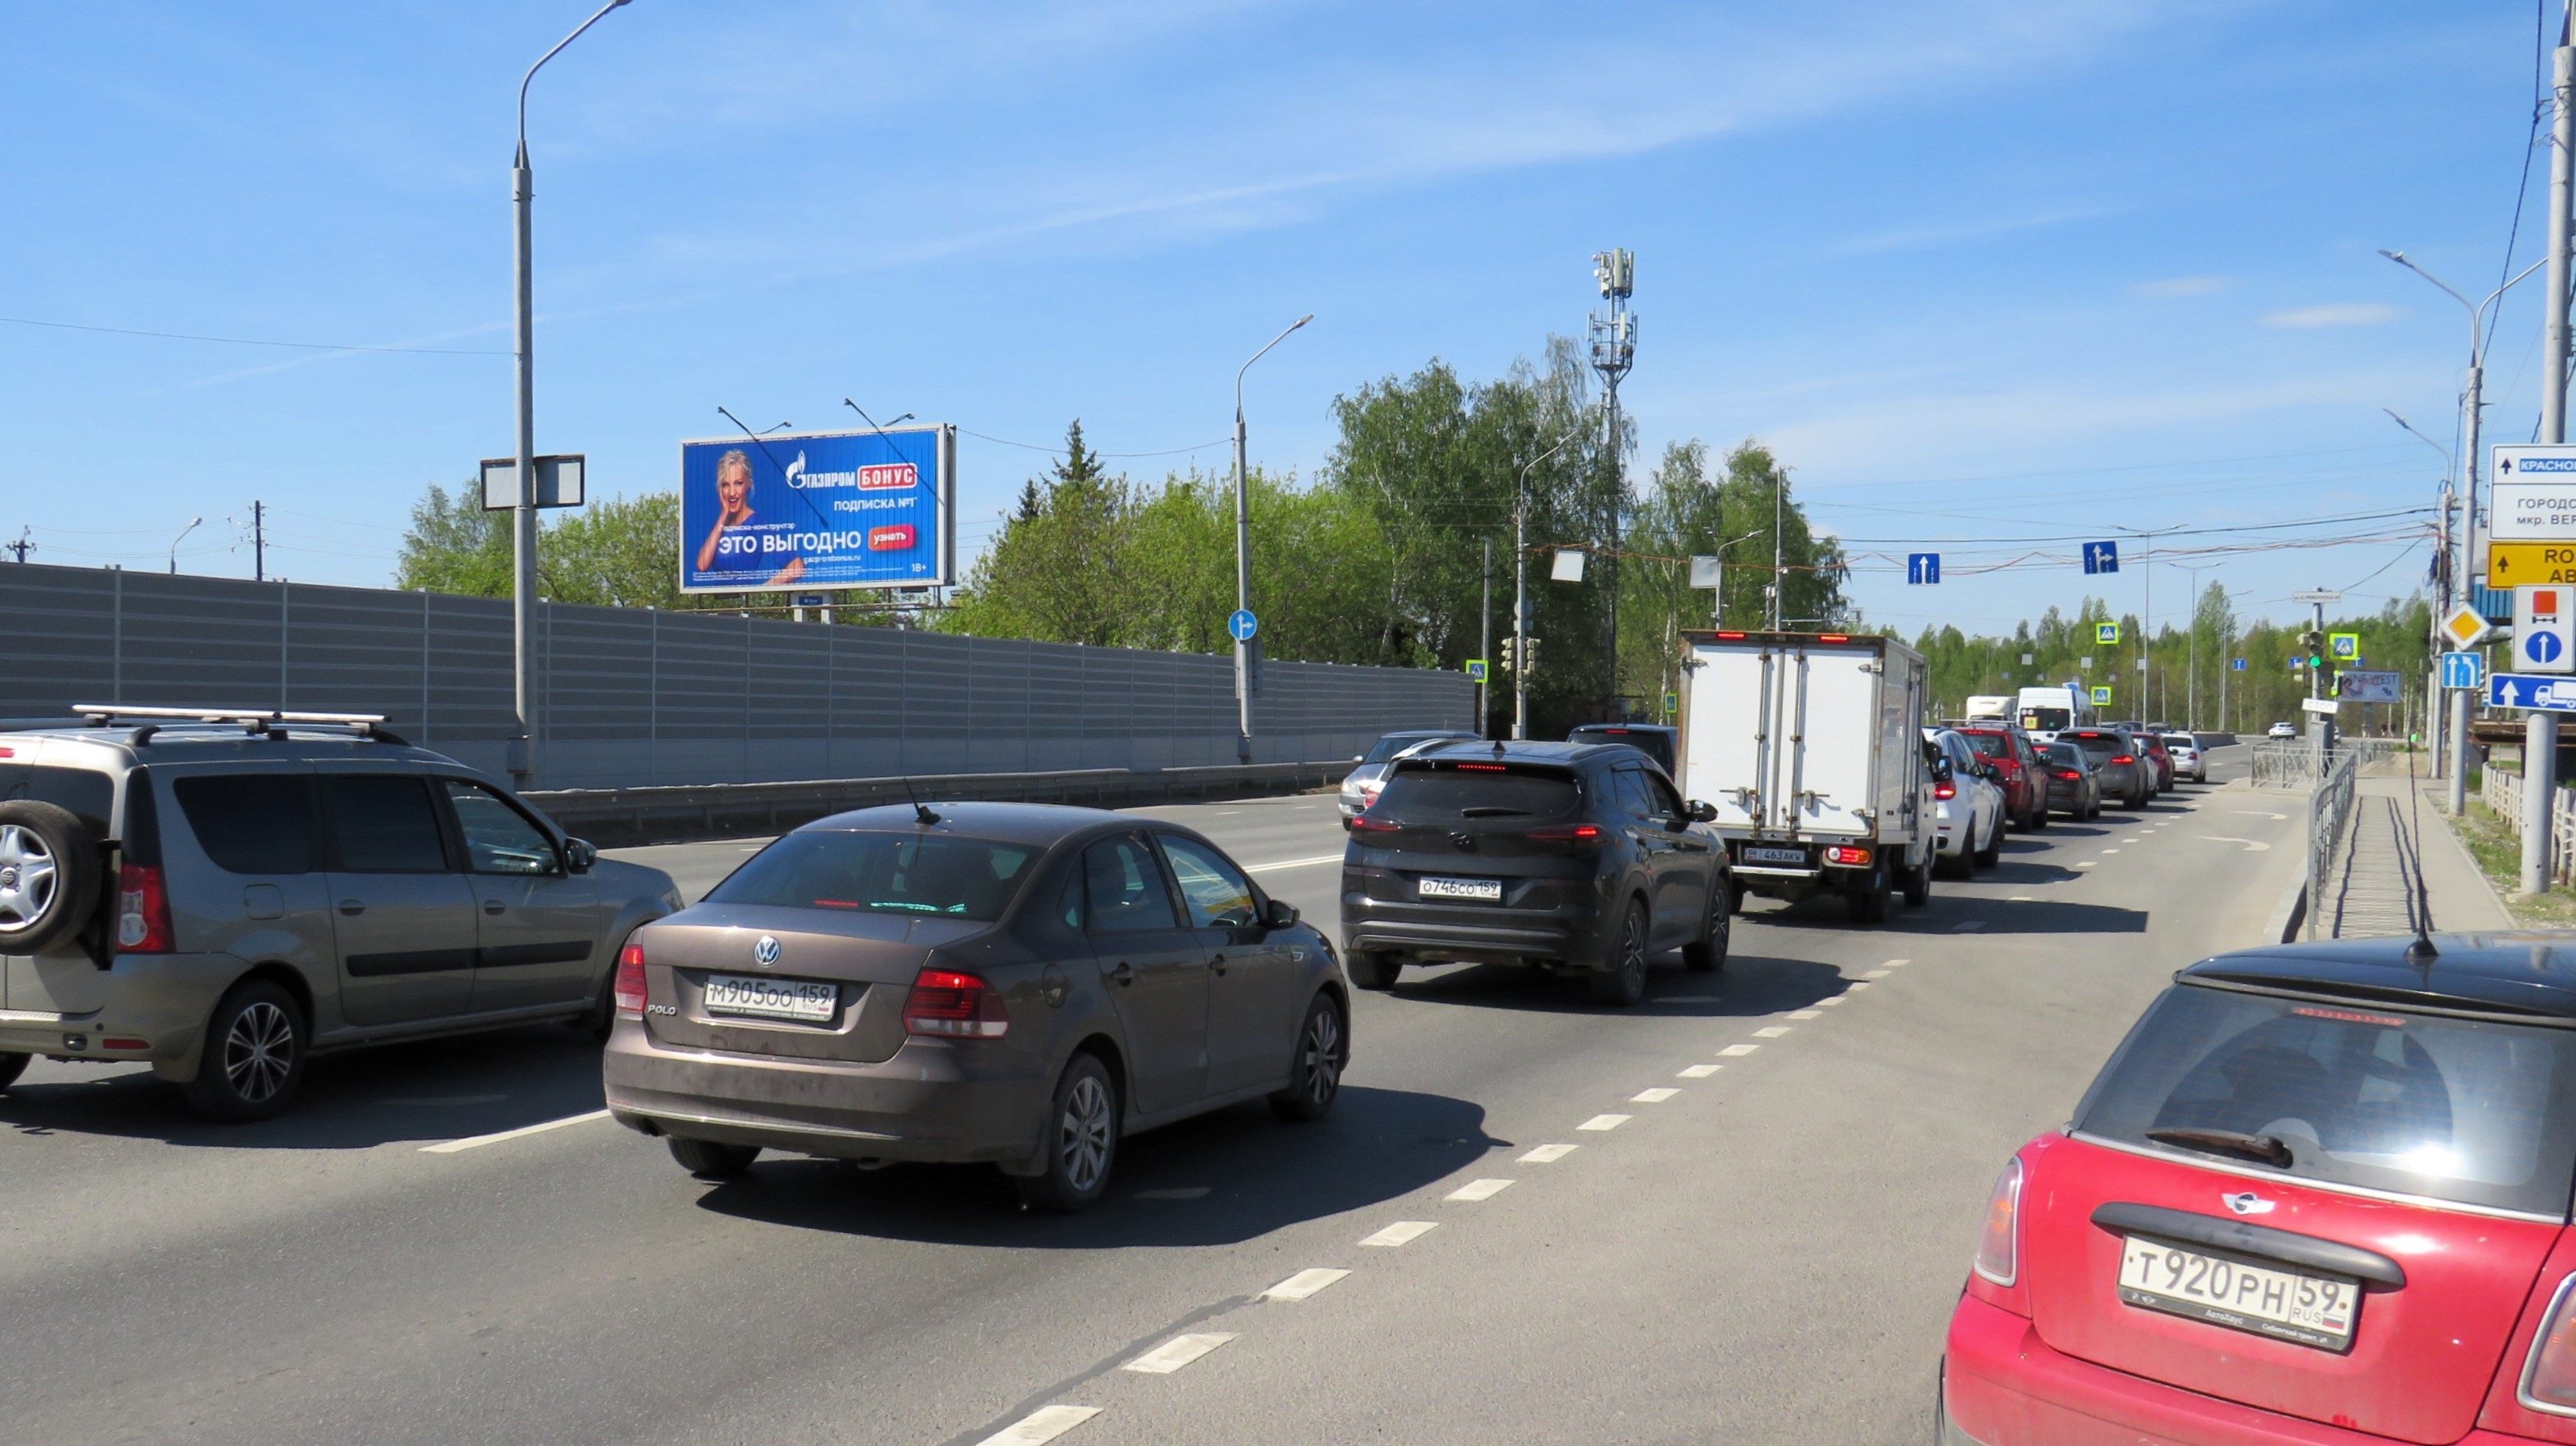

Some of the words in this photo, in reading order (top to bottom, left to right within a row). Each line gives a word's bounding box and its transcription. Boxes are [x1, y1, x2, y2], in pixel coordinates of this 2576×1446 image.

[2520, 460, 2576, 471] КРАСНО
[807, 471, 856, 488] ГАЗПРОМ
[861, 467, 913, 486] БОНУС
[834, 498, 896, 512] ПОДПИСКА
[2516, 516, 2546, 527] мкр.
[719, 535, 758, 554] ЭТО
[762, 531, 862, 554] ВЫГОДНО
[873, 531, 907, 545] узнать
[2544, 549, 2576, 564] RO
[910, 562, 927, 573] 18+
[2307, 700, 2333, 711] СТОП
[1423, 878, 1475, 895] О746СО
[1478, 881, 1497, 893] 159
[712, 980, 793, 1008] М905ОО
[798, 984, 830, 1005] 159
[648, 1005, 677, 1016] POLO
[801, 1002, 818, 1011] RUS
[2139, 1248, 2286, 1314] Т920РН
[2298, 1277, 2339, 1311] 59
[2292, 1307, 2322, 1324] RUS
